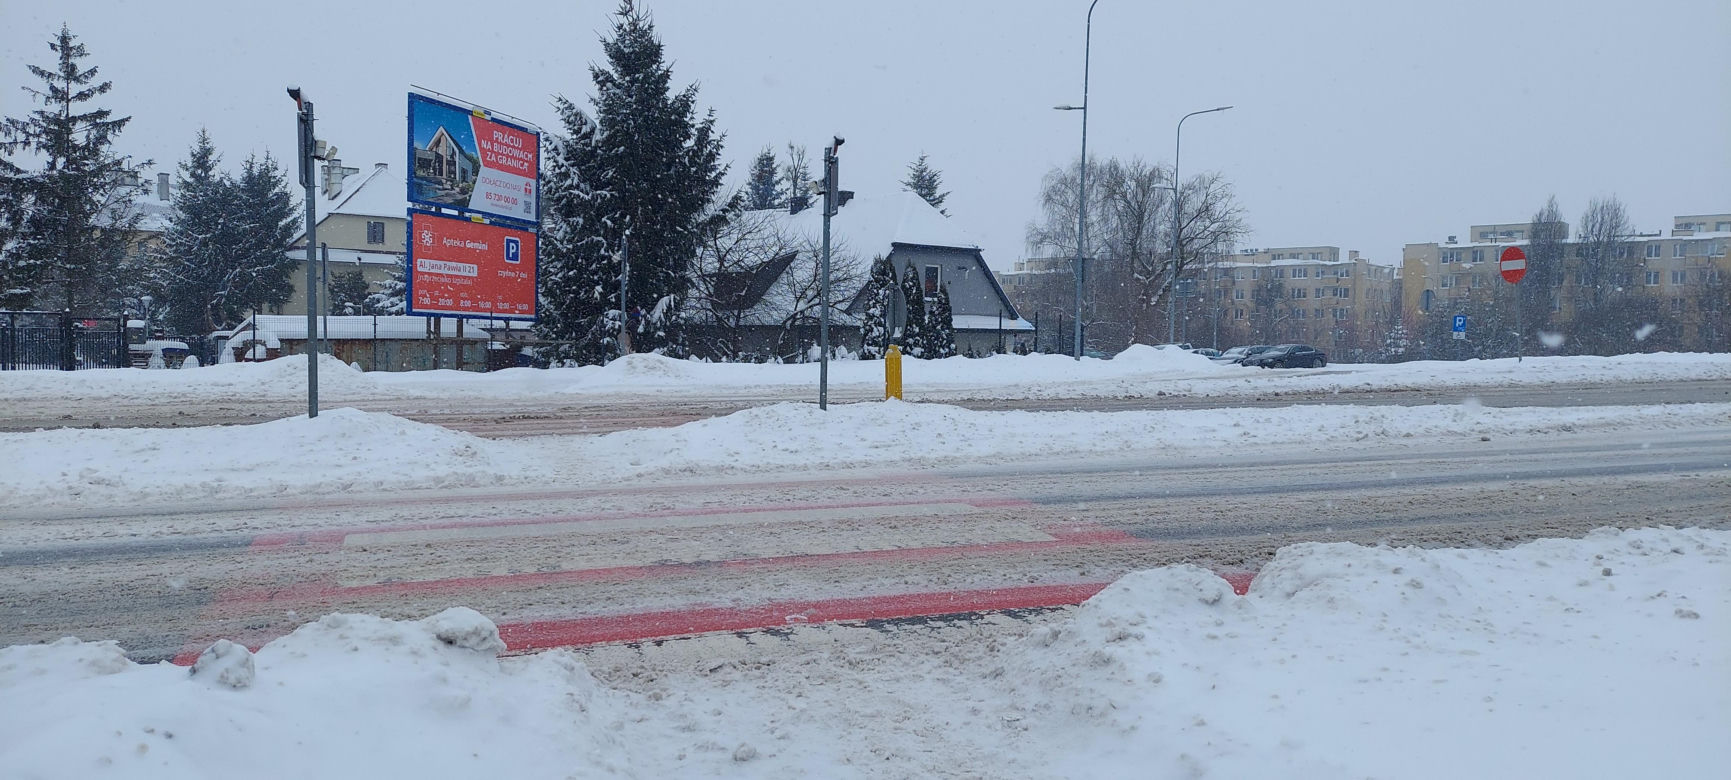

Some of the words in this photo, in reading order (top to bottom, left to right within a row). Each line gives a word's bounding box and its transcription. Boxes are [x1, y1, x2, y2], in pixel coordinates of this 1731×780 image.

[493, 131, 522, 148] PRACUJ
[481, 139, 492, 150] NA
[493, 142, 533, 162] BUDOWACH
[486, 151, 497, 162] ZA
[497, 155, 529, 172] GRANICĄ
[442, 237, 464, 248] Apteka
[465, 240, 488, 251] Gemini
[509, 242, 516, 258] P
[419, 260, 428, 269] Al.
[428, 262, 442, 271] Jana
[468, 265, 475, 274] 21
[418, 296, 431, 305] 7:00
